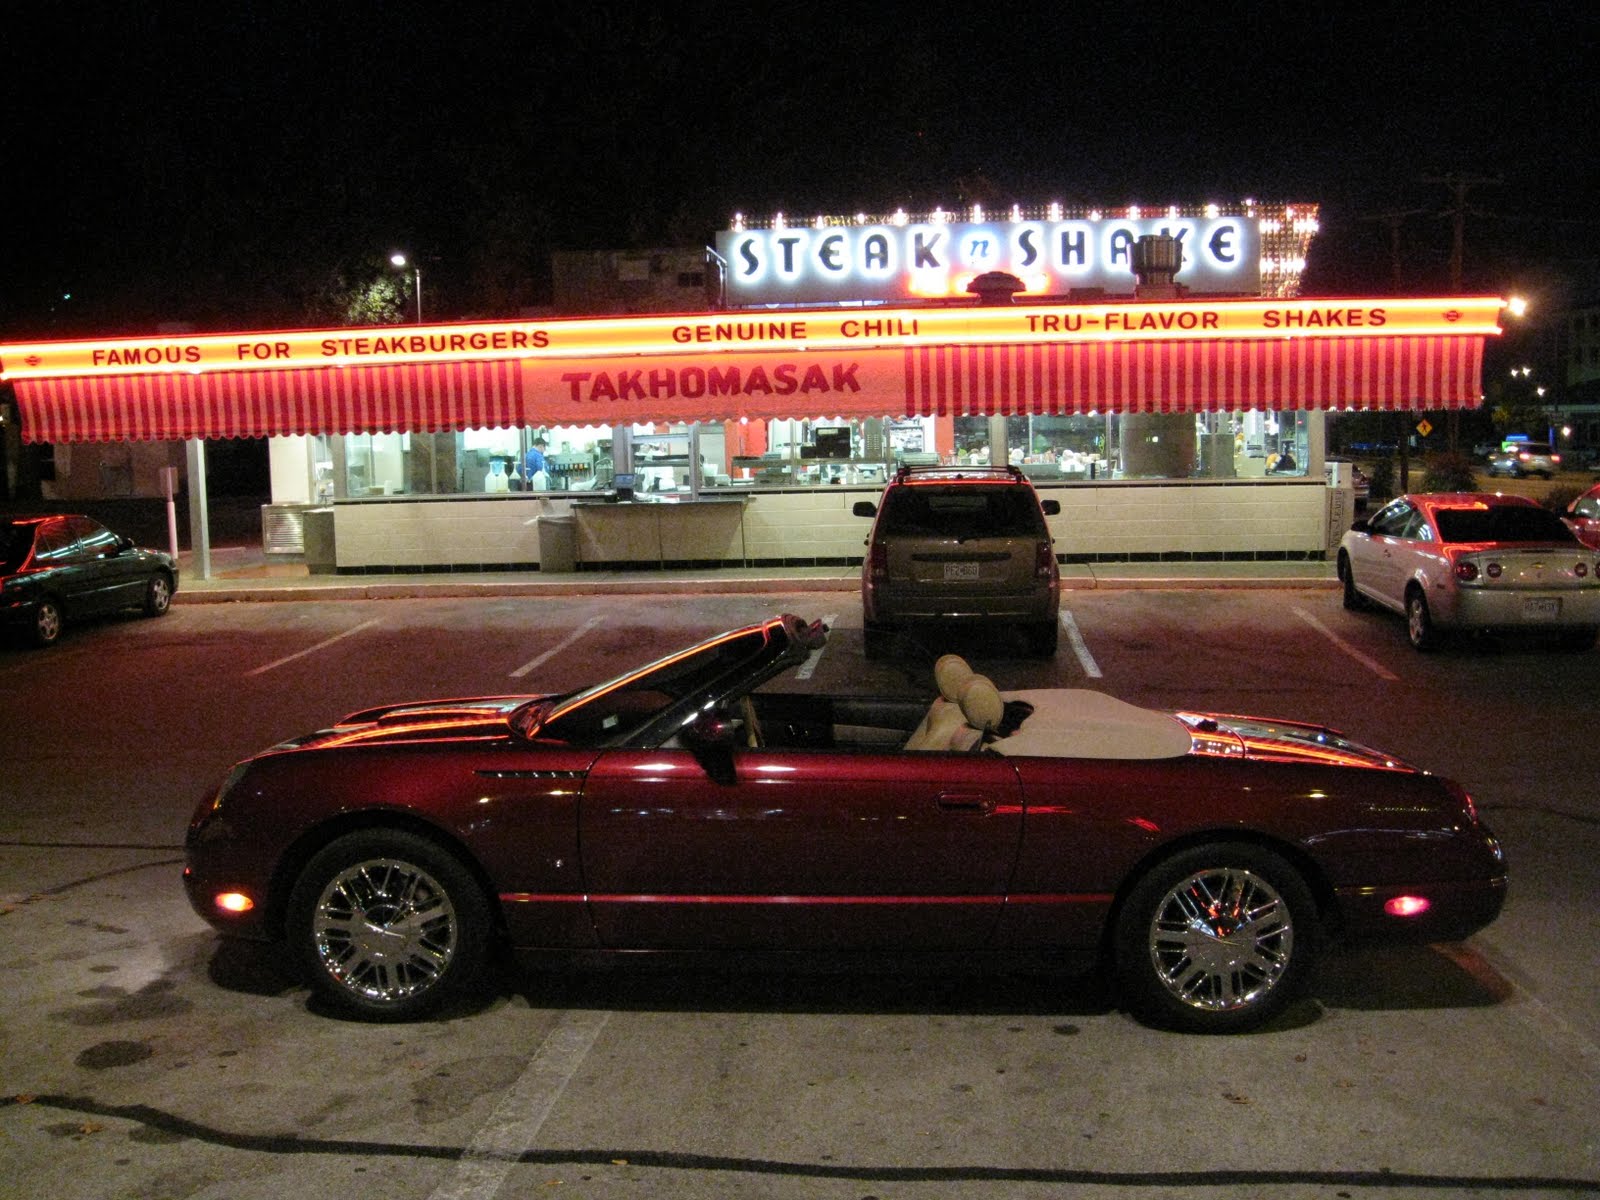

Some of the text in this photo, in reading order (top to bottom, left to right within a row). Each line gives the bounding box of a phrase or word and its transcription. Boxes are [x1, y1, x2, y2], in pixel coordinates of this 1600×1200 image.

[740, 232, 942, 275] STEAK
[92, 308, 1387, 366] FAMOUS FOR STEAKBURGERS GENUINE CHILI TRU-FLAVOR SHAKES
[561, 362, 862, 404] TAKHOMASAK
